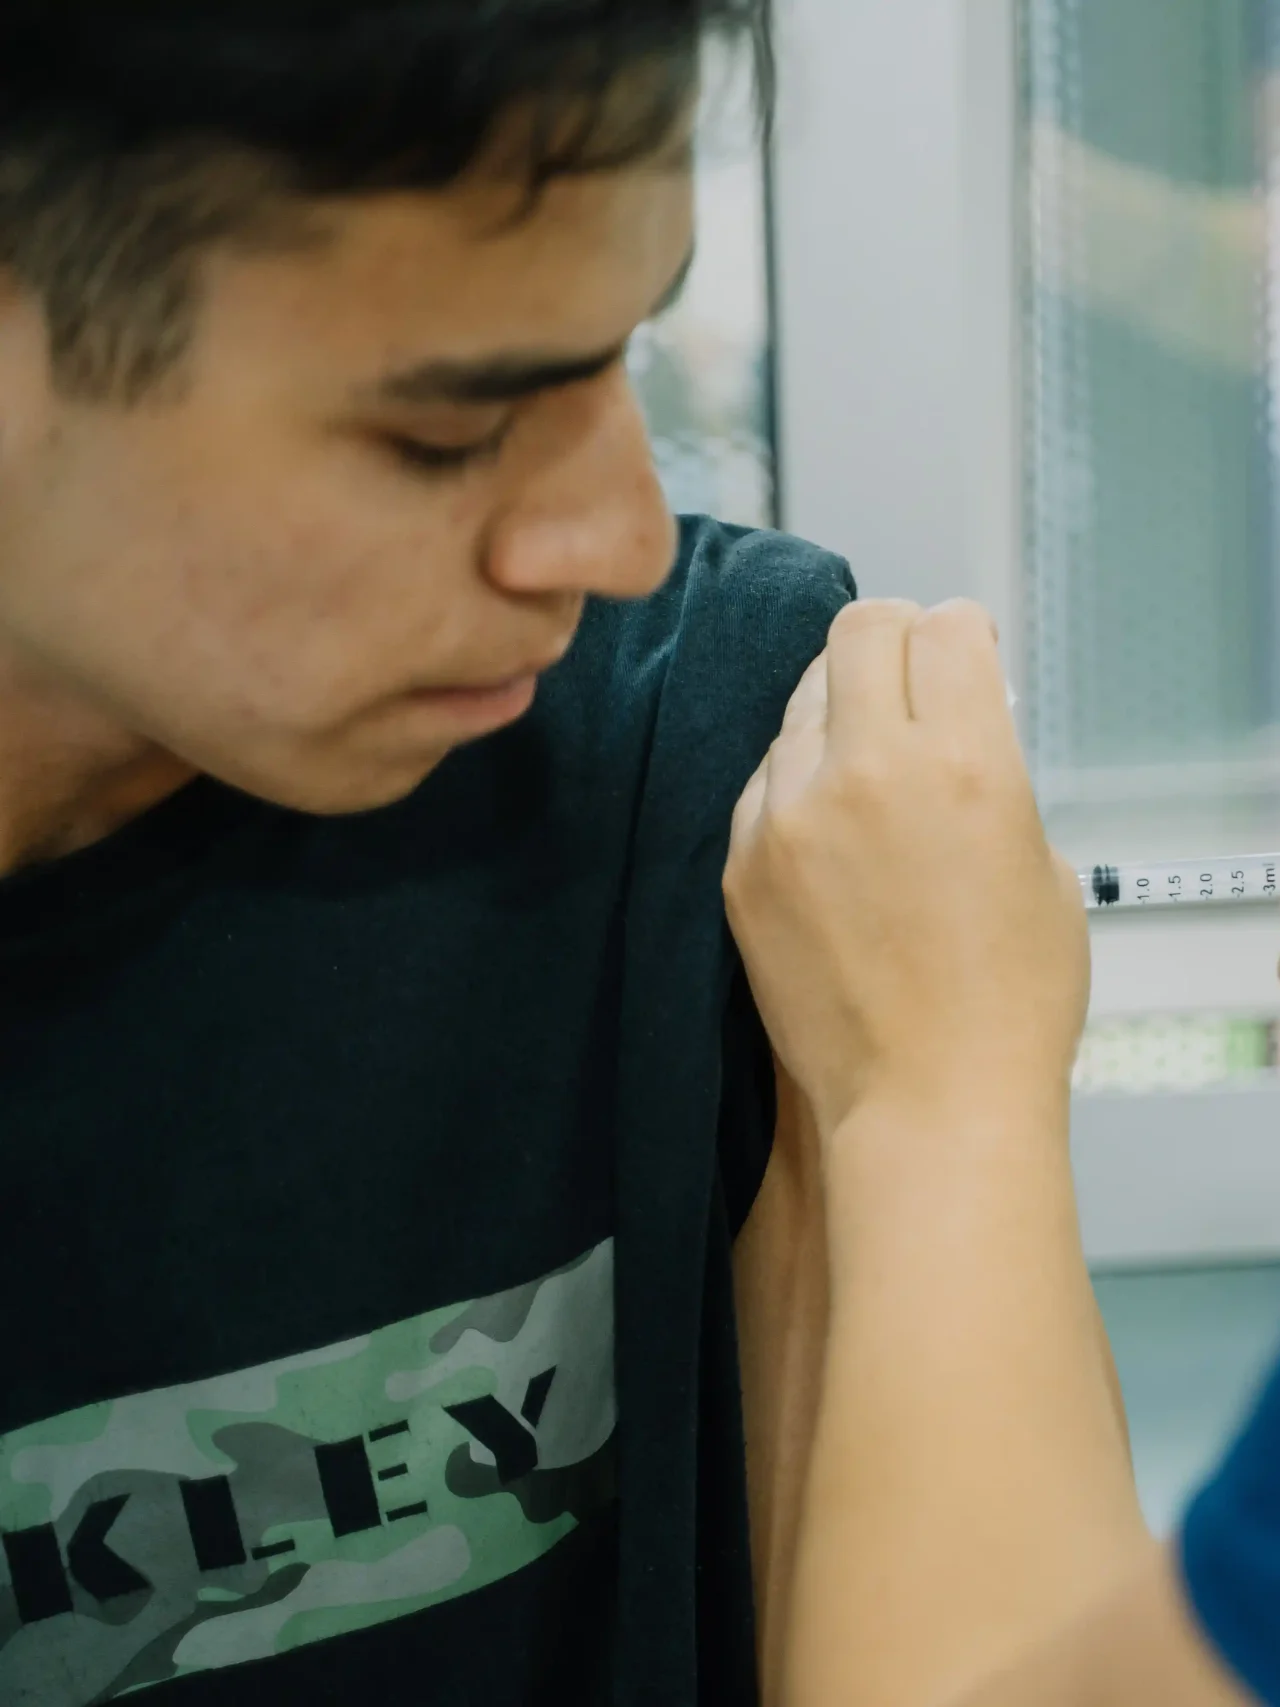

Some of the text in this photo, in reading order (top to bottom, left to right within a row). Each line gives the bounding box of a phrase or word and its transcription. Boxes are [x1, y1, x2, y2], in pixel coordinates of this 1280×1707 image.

[1136, 878, 1150, 900] 1.0
[1168, 875, 1182, 897] 1.5
[1199, 873, 1213, 895] 2.0
[1231, 870, 1244, 893] 2.5
[2, 1364, 557, 1625] KLEY
